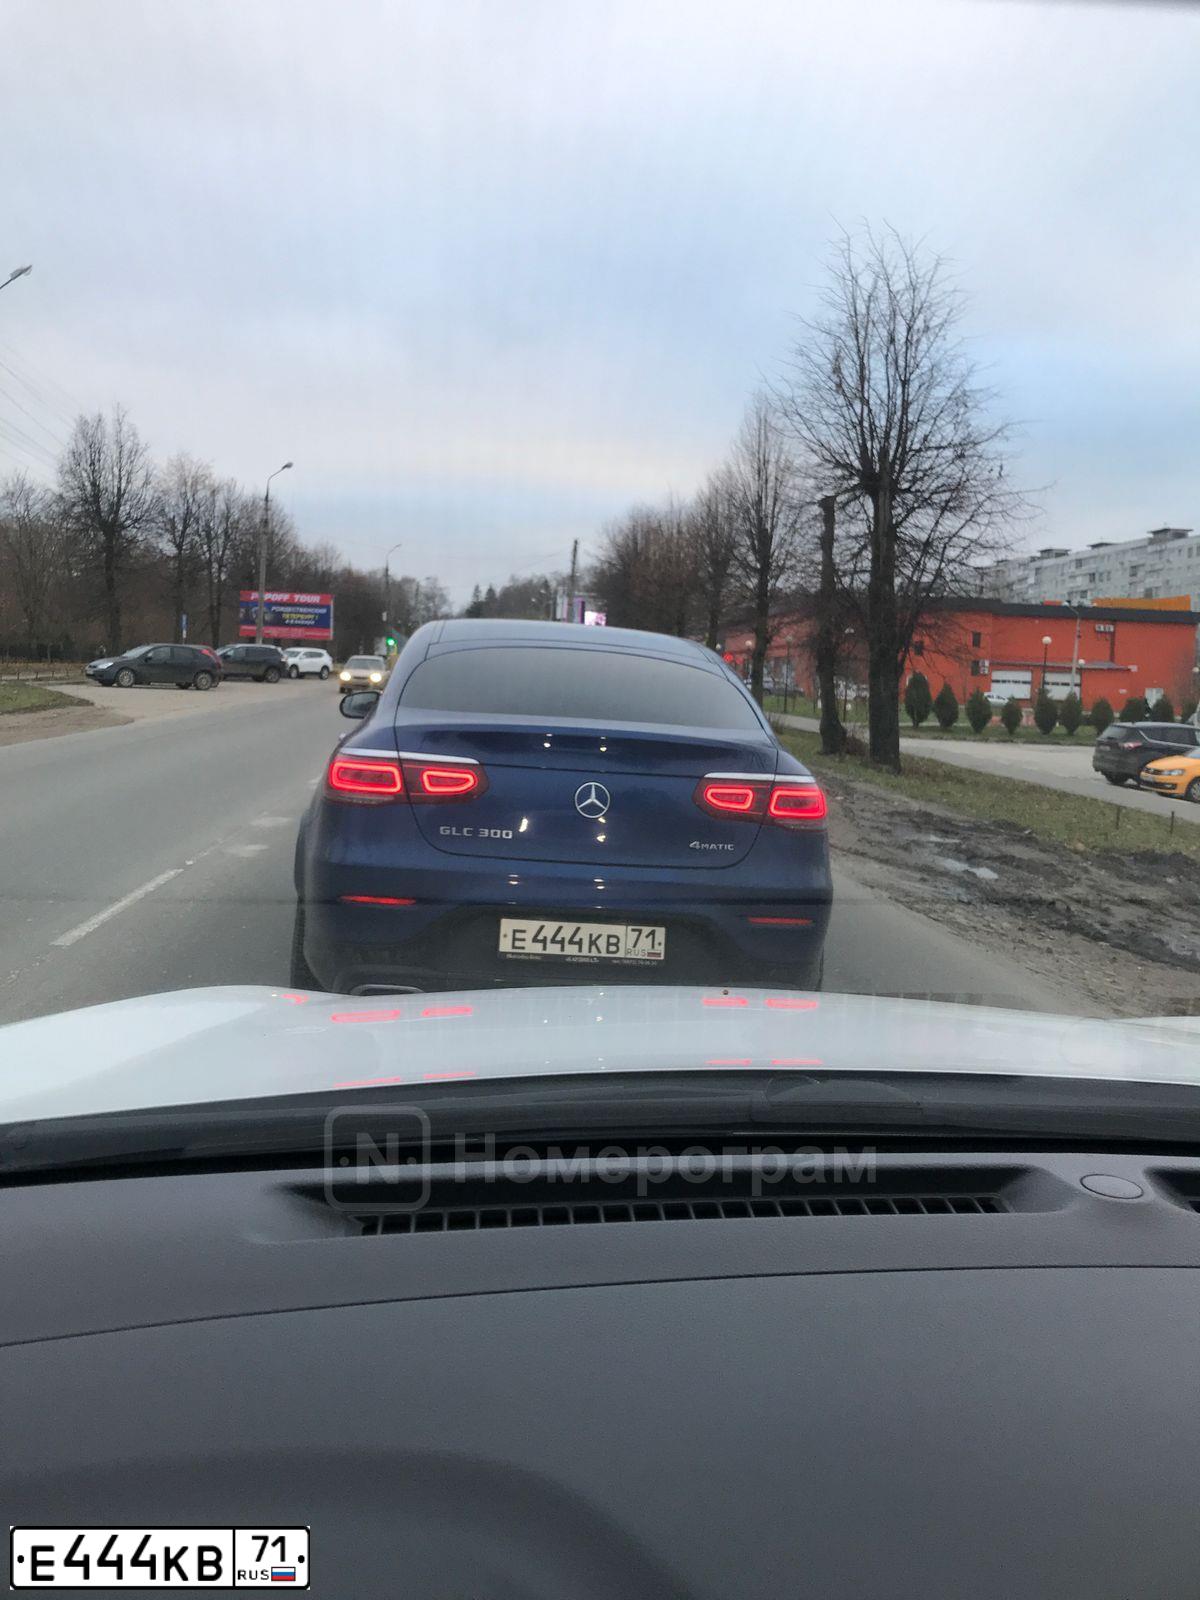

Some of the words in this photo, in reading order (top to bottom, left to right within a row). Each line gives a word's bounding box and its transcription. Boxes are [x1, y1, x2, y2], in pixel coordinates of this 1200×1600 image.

[250, 592, 289, 602] PPOFF
[294, 593, 320, 603] TOUR
[439, 826, 473, 837] GLC
[478, 828, 513, 839] 300
[689, 841, 735, 851] 4MATIC
[511, 924, 620, 955] Е444КВ
[631, 928, 657, 950] 71
[626, 949, 647, 957] RUS
